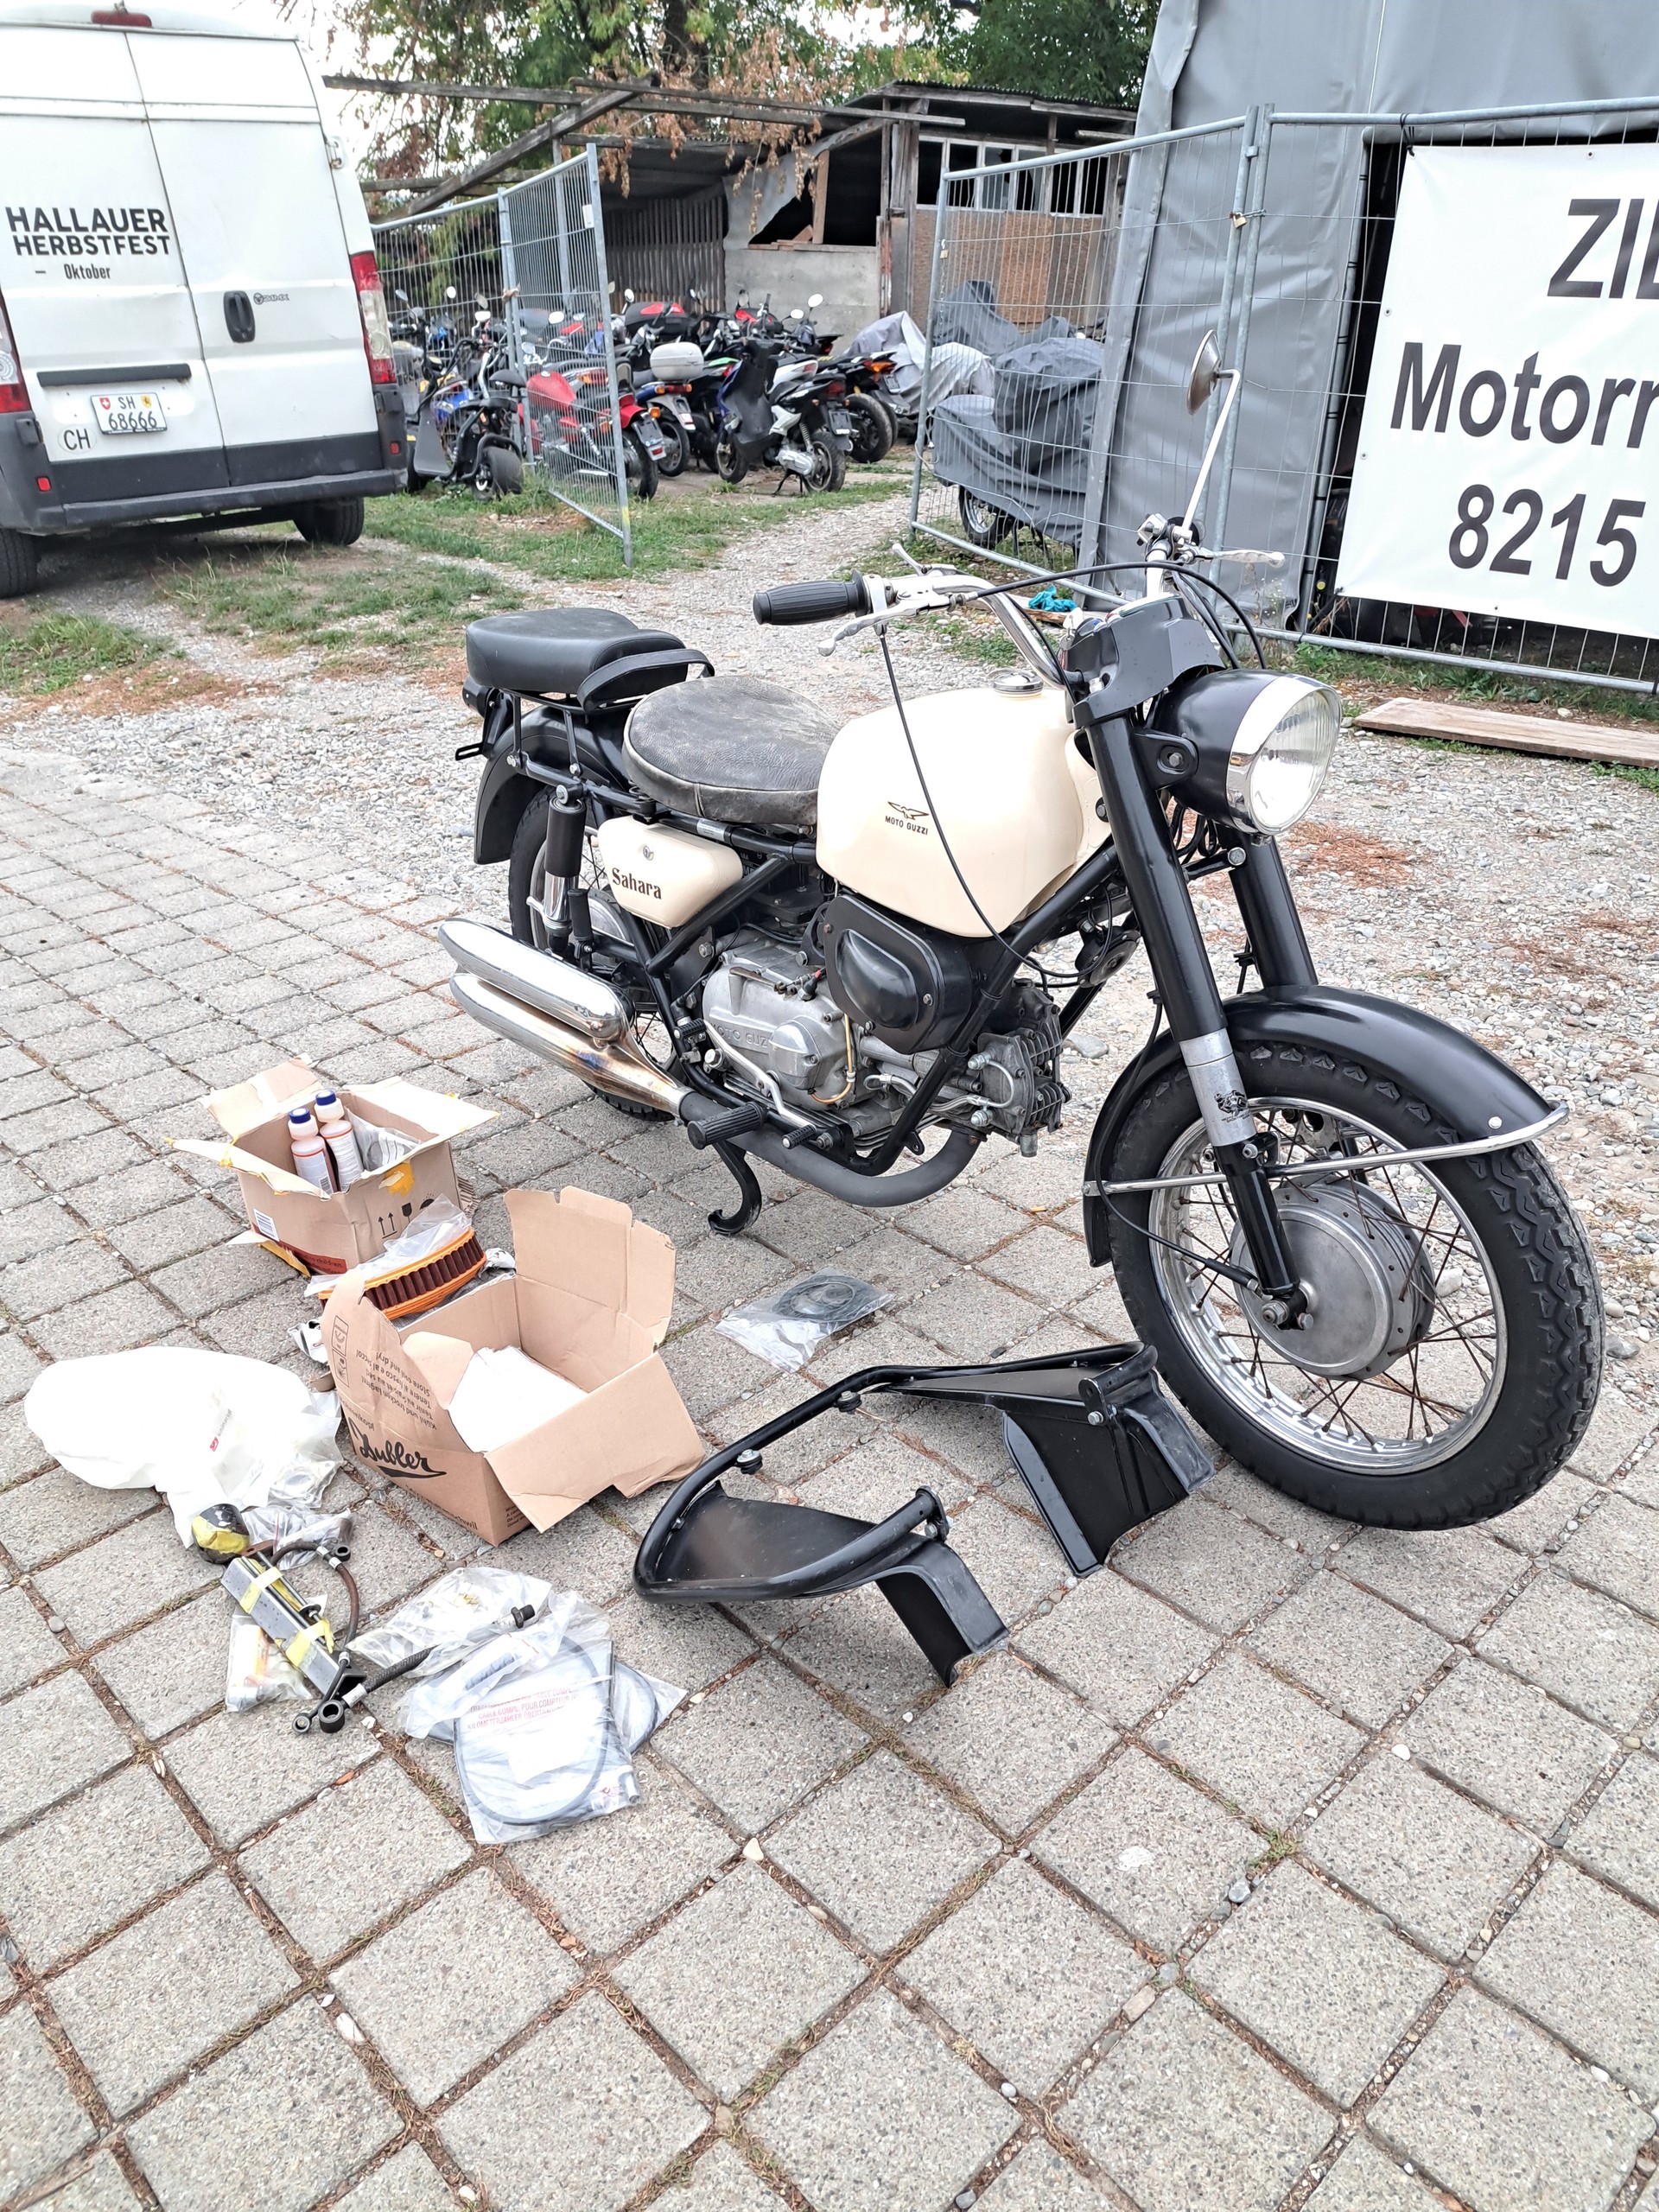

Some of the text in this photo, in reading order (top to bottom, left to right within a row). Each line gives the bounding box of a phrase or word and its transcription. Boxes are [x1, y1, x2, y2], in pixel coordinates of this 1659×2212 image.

[4, 207, 168, 232] HALLAUER
[12, 235, 170, 256] HERBSTFEST
[63, 263, 111, 280] Oktober
[118, 396, 136, 410] SH
[108, 410, 157, 430] 68666
[63, 429, 91, 450] CH
[1448, 484, 1646, 587] 8215
[885, 816, 929, 836] MOTO GUZZI
[612, 868, 662, 899] Sahara
[745, 1033, 770, 1048] GUZ
